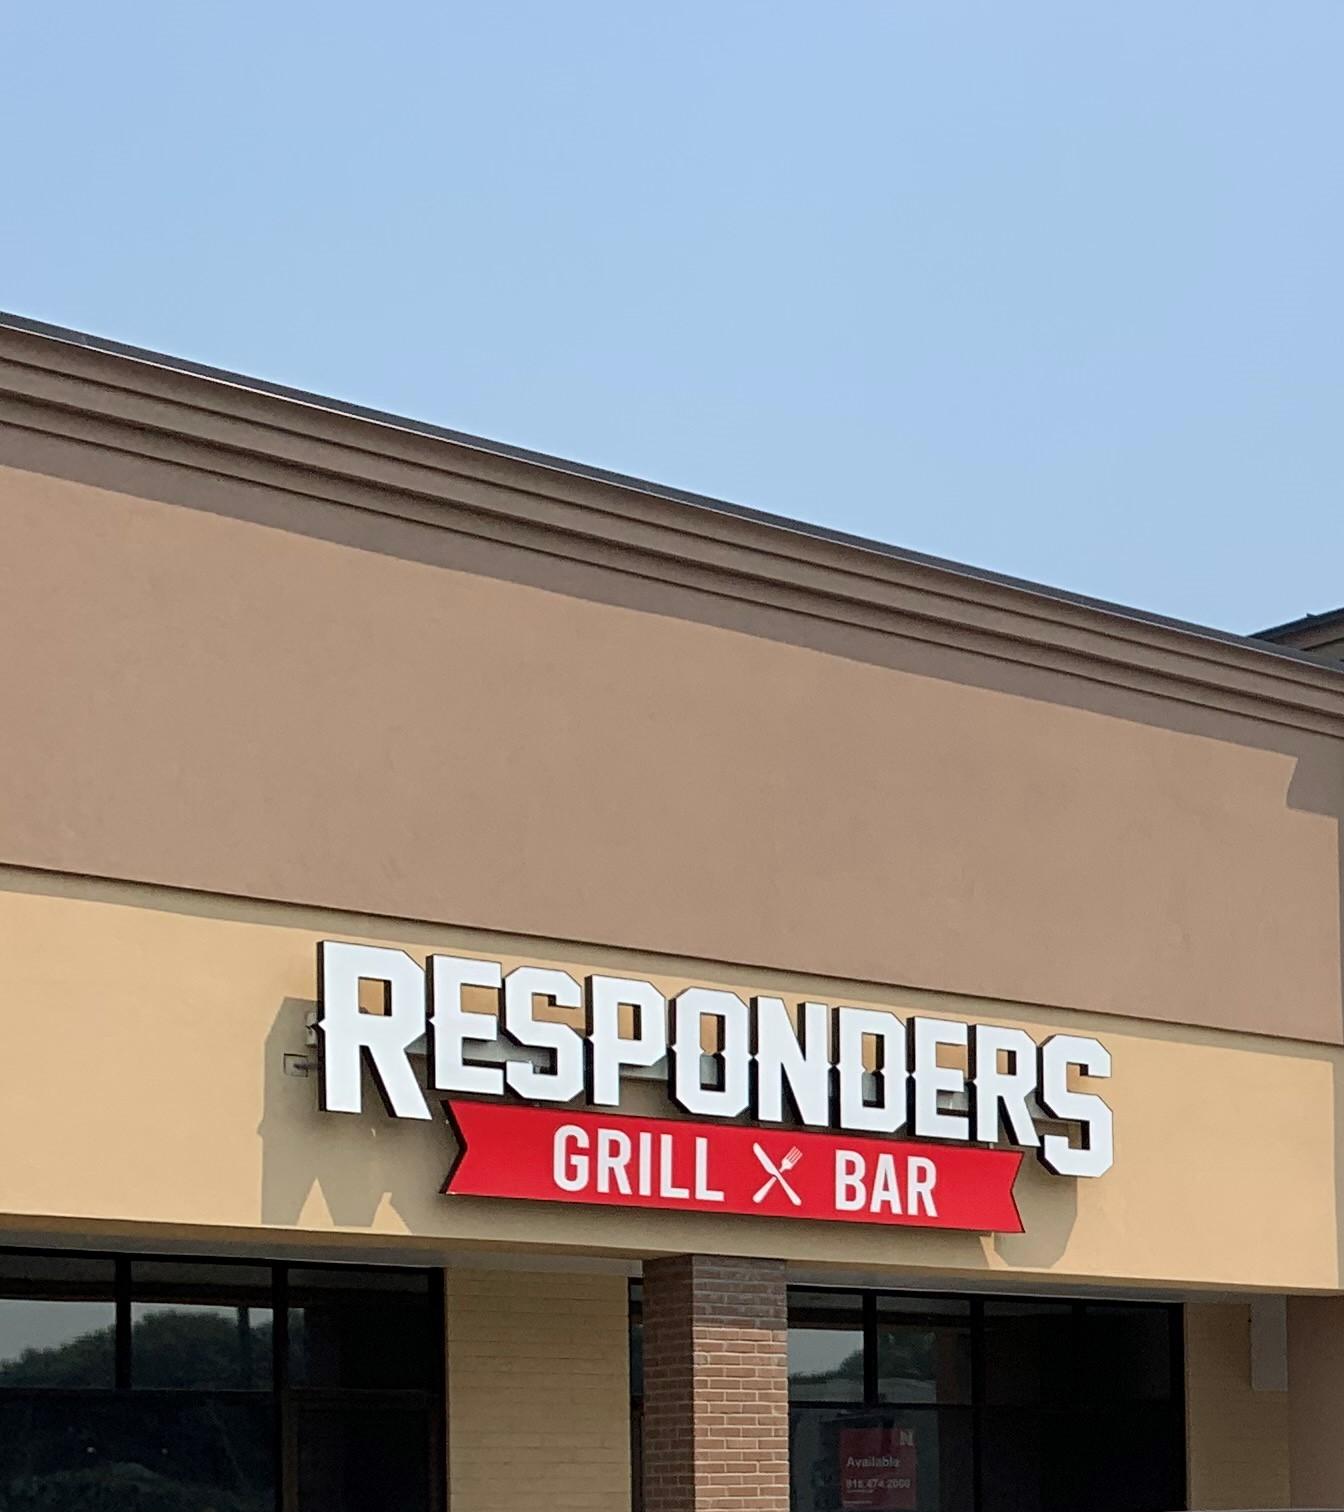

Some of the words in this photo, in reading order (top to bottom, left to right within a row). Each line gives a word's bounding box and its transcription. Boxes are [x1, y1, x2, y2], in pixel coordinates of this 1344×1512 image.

[317, 940, 1114, 1177] RESPONDERS
[553, 1124, 725, 1202] GRILL
[835, 1149, 939, 1217] BAR
